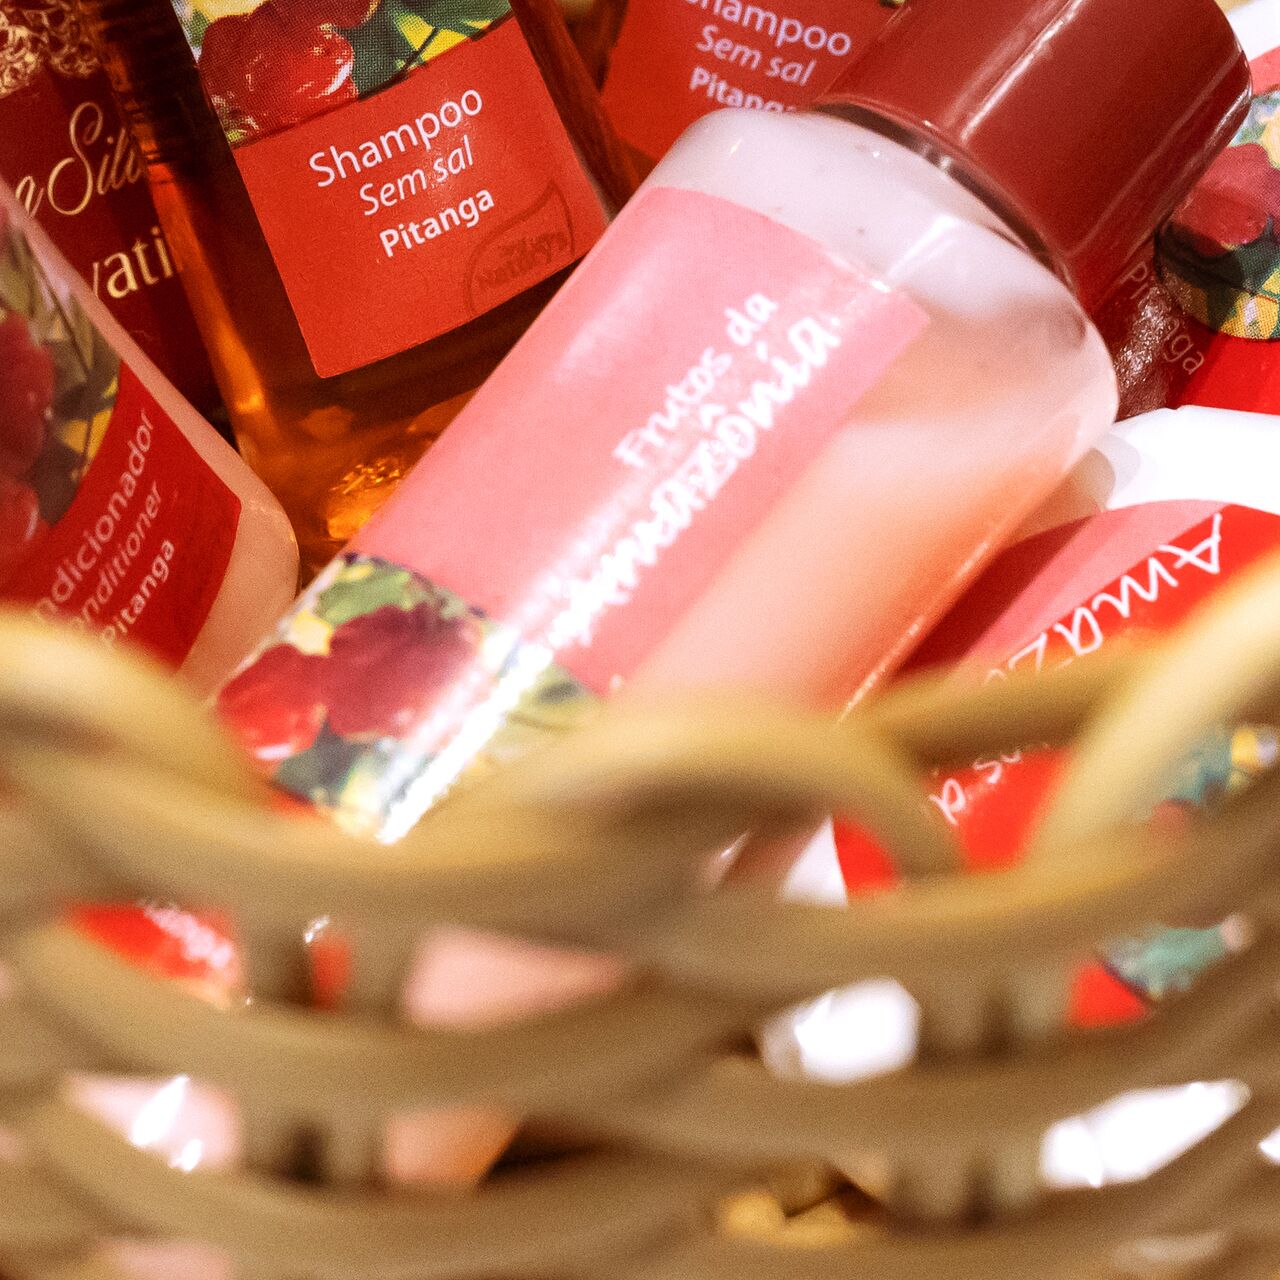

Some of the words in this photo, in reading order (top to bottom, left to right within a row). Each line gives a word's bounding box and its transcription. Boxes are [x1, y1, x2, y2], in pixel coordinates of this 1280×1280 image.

[689, 66, 797, 113] Pitan
[696, 24, 763, 70] Sem
[766, 55, 817, 87] sal
[309, 89, 483, 188] Shampoo
[359, 167, 427, 216] Sem
[432, 135, 475, 184] sal
[379, 188, 495, 258] Pitanga
[612, 346, 734, 469] Frutos
[724, 293, 779, 347] da
[983, 512, 1223, 688] Amaz
